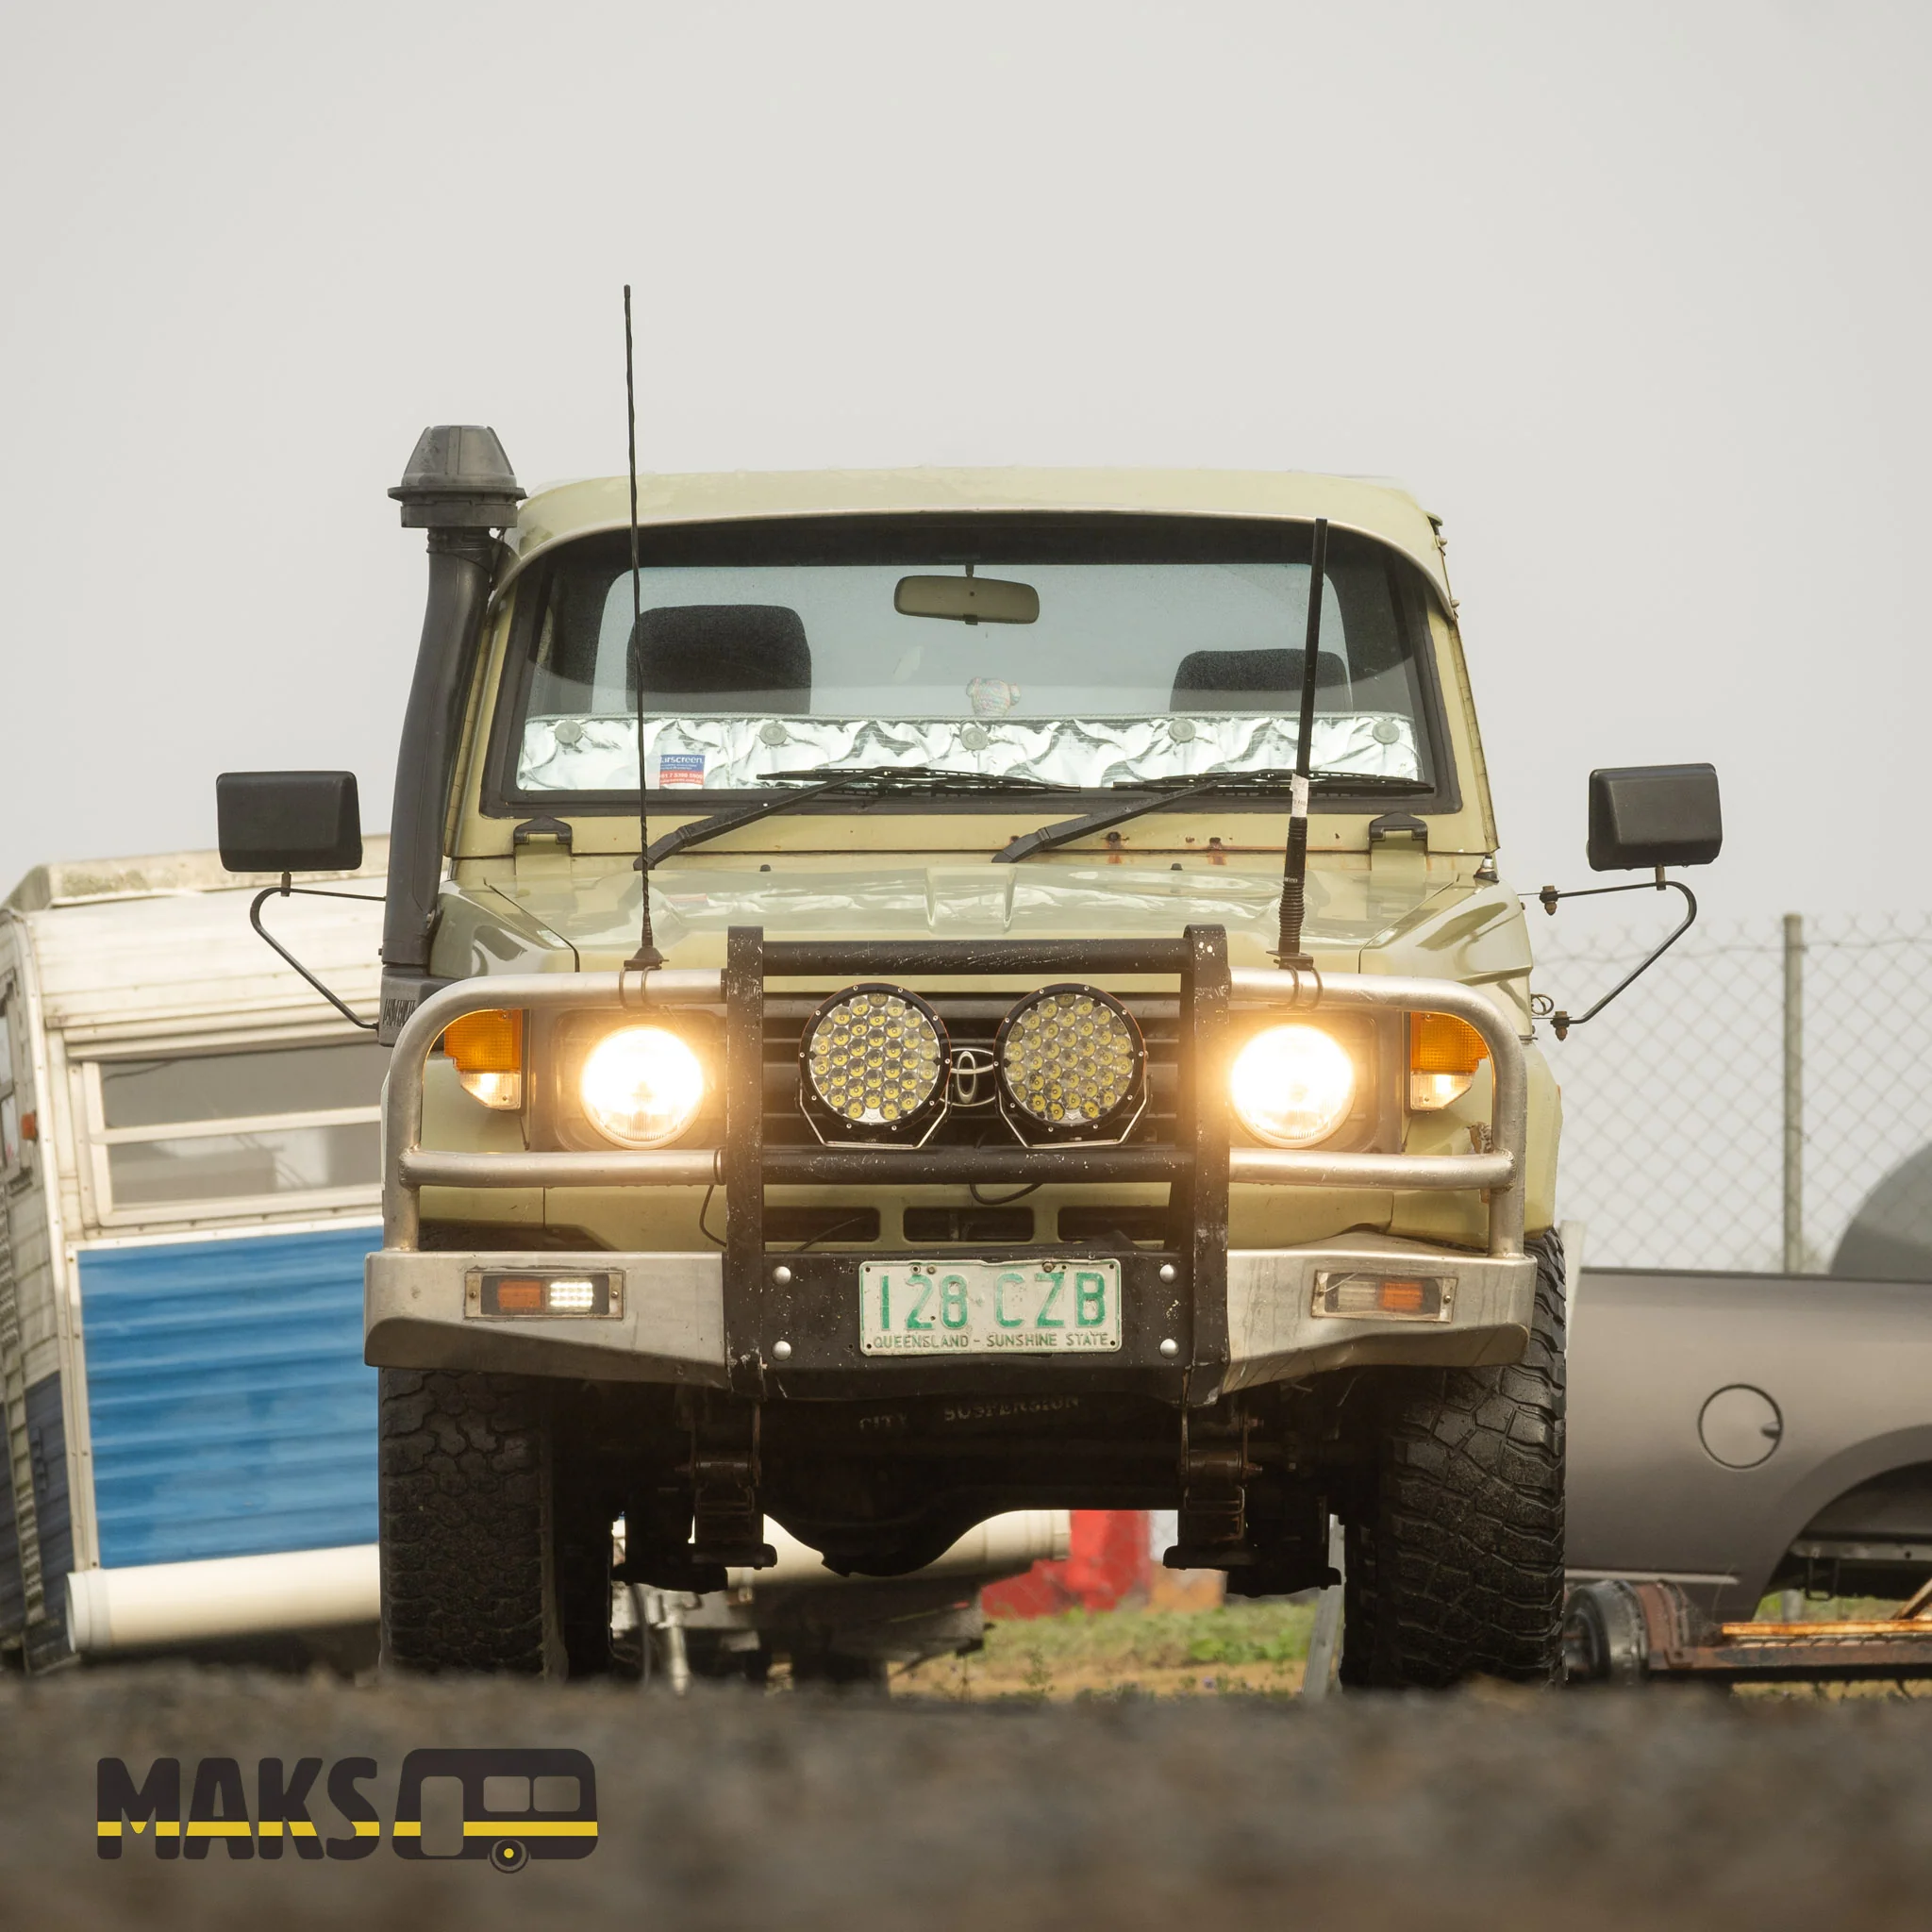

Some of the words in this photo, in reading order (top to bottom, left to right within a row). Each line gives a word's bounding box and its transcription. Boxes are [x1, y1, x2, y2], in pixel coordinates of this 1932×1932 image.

[880, 1274, 969, 1330] 128
[996, 1272, 1107, 1329] CZB
[874, 1334, 970, 1349] QUEENSLAND
[987, 1334, 1058, 1348] SUNSHINE
[1066, 1333, 1108, 1347] STATE
